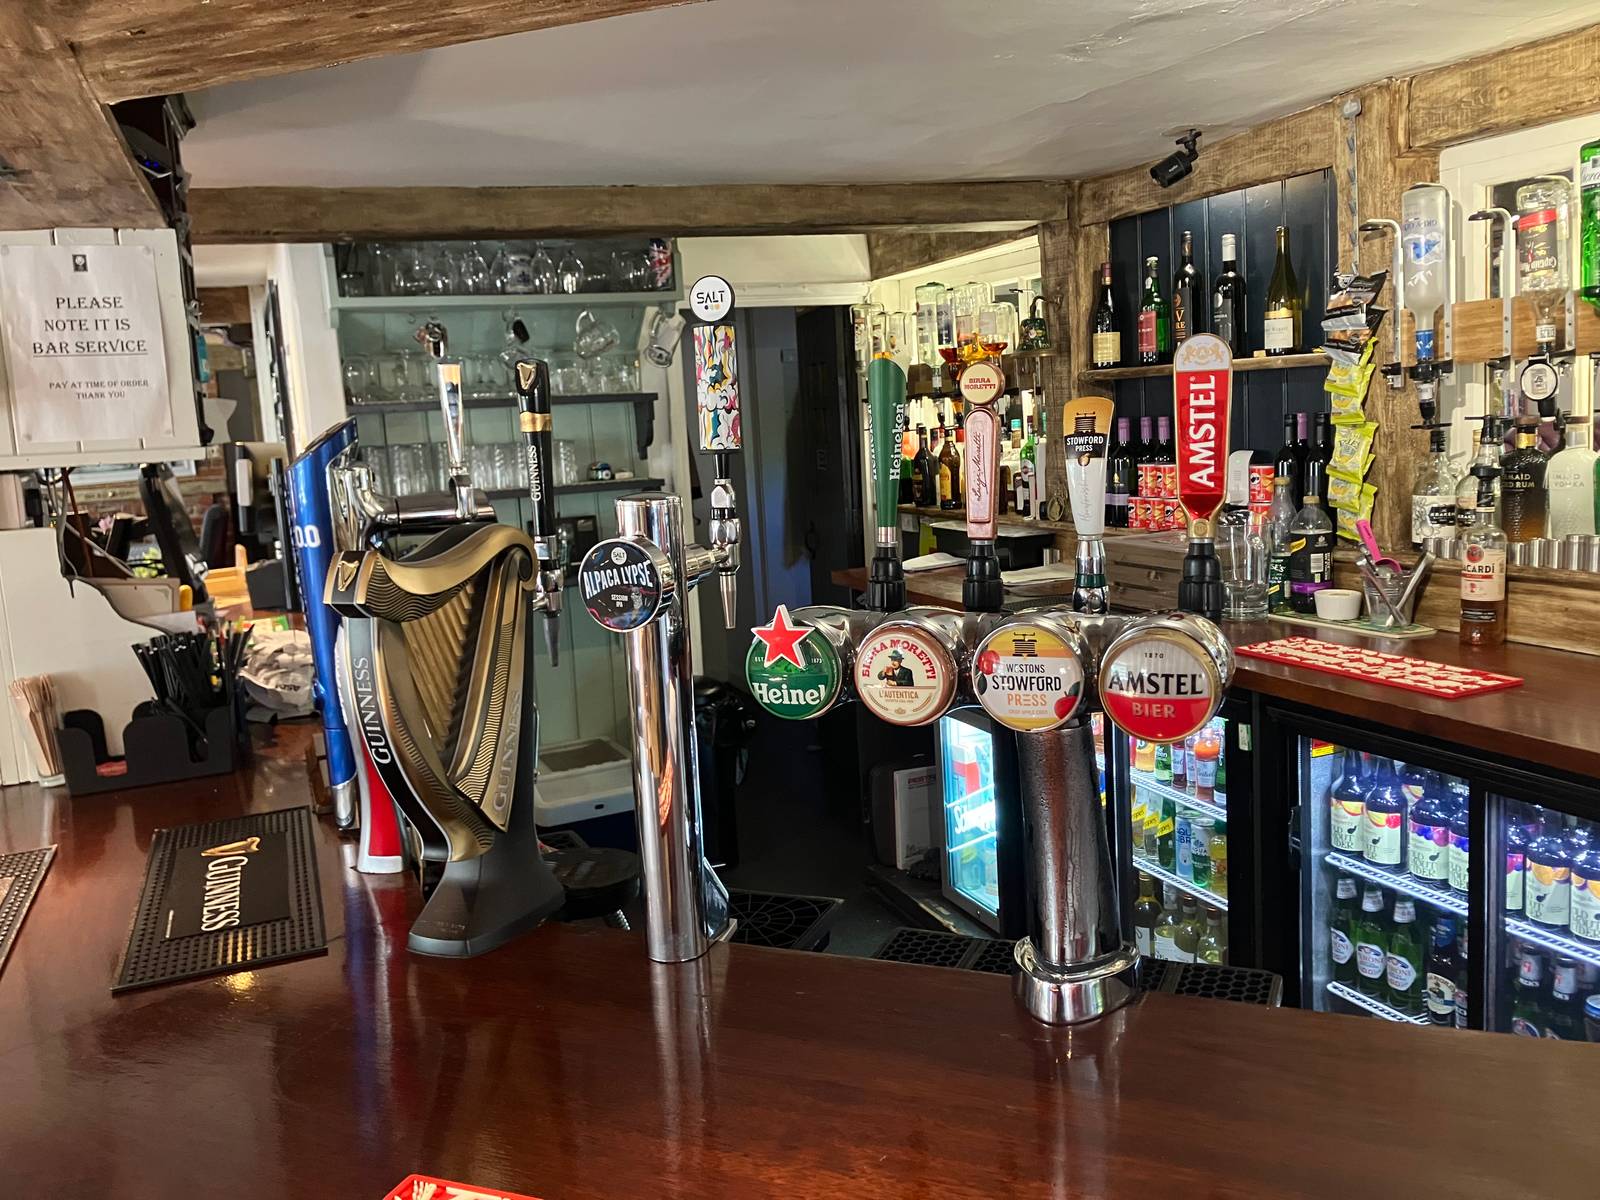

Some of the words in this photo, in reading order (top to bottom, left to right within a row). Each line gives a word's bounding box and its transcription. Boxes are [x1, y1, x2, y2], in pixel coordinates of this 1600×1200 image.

[56, 296, 124, 309] PLEASE
[696, 290, 725, 304] SALT
[44, 319, 90, 332] NOTE
[94, 319, 110, 331] IT
[115, 318, 131, 331] IS
[33, 341, 70, 354] BAR
[75, 339, 148, 354] SERVICE
[49, 381, 68, 390] PAY
[70, 381, 83, 389] AT
[85, 381, 106, 389] TIME
[107, 380, 118, 388] OF
[120, 380, 149, 389] ORDER
[76, 392, 106, 400] THANK
[108, 391, 126, 400] YOU
[1189, 374, 1216, 488] AMSTEL
[888, 403, 904, 480] Heineken
[1066, 435, 1104, 446] STOWFORD
[1075, 444, 1093, 452] PRESS
[530, 444, 541, 502] GUINNESS
[583, 568, 621, 600] ALPACA
[620, 559, 653, 587] LYPSE
[890, 639, 937, 680] MORETTI
[1006, 663, 1046, 674] WESTONS
[992, 675, 1062, 691] STOWFORD
[1108, 672, 1204, 695] AMSTEL
[879, 689, 919, 699] L'AUTENTICA
[1007, 693, 1048, 707] PRESS
[353, 656, 391, 764] GUINNESS
[1132, 702, 1176, 718] BIER
[493, 690, 521, 811] GUINNESS
[201, 855, 249, 932] GUINNESS
